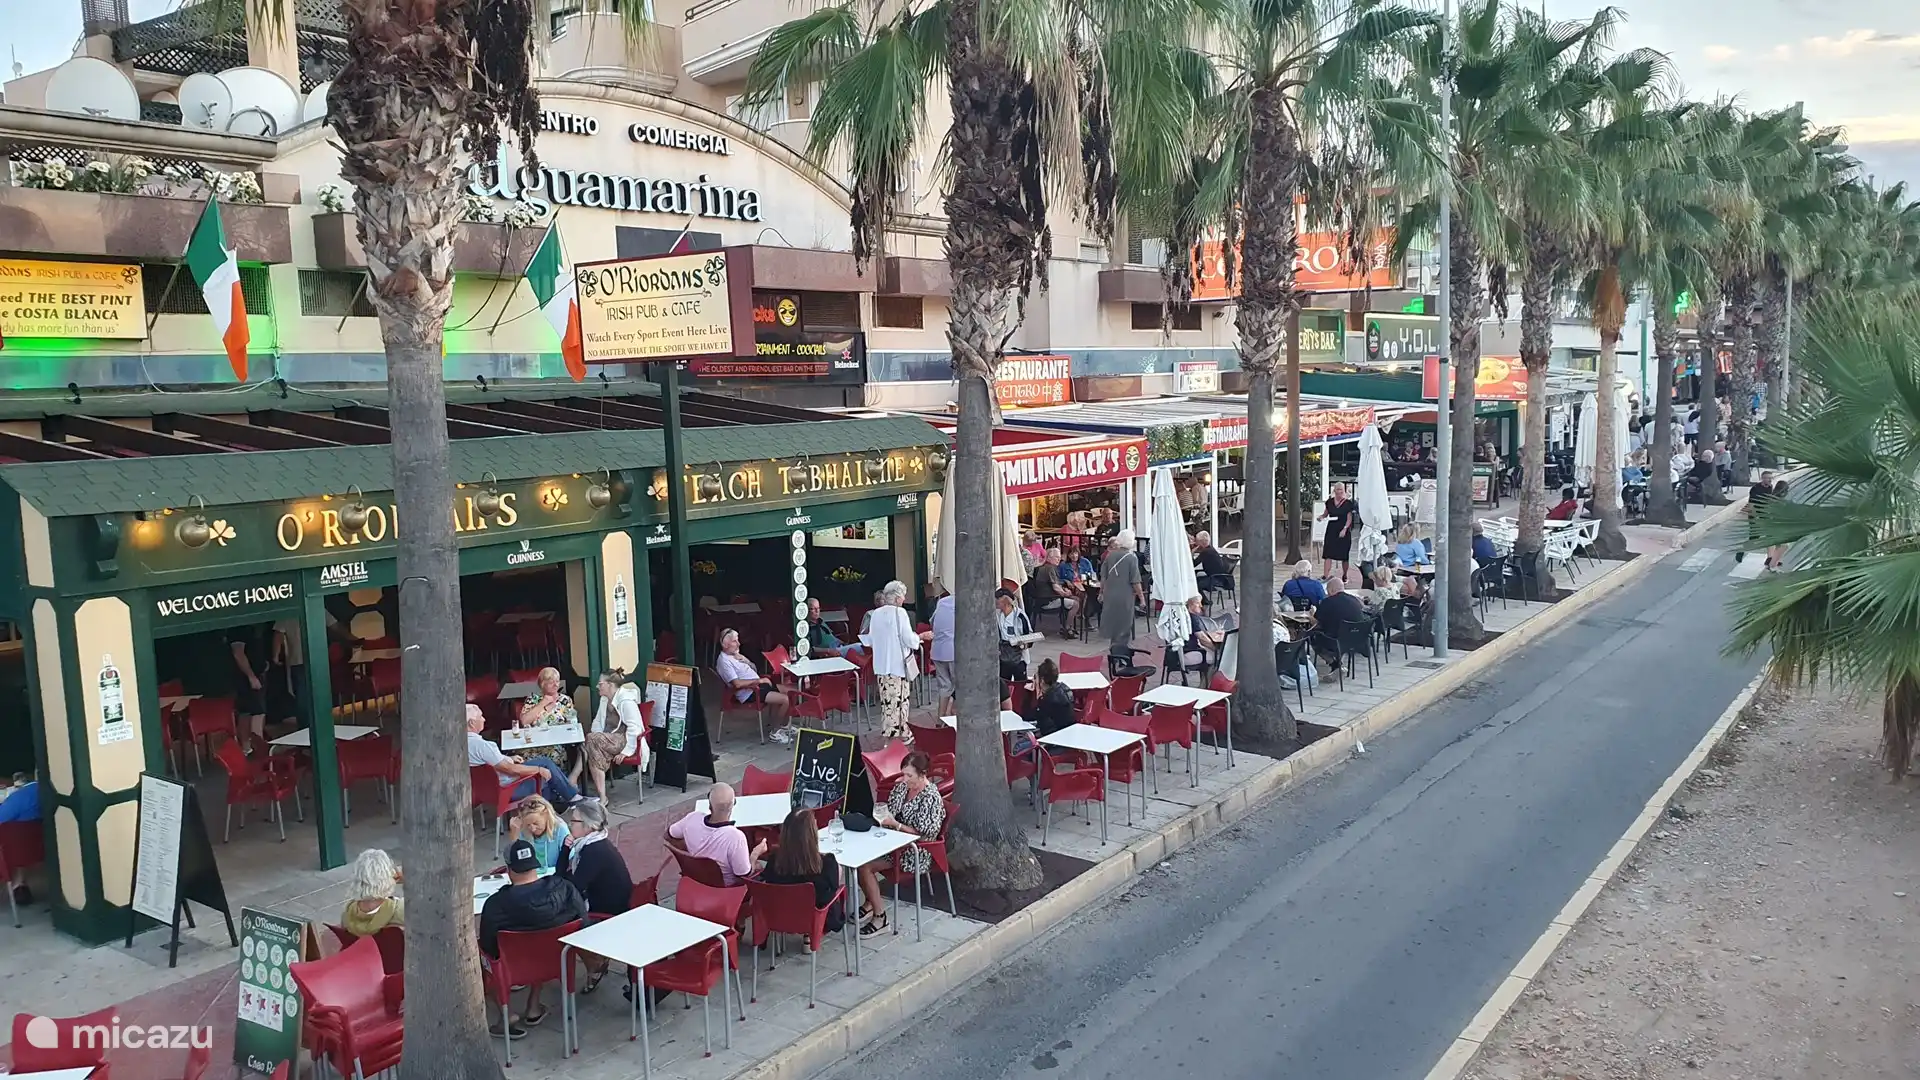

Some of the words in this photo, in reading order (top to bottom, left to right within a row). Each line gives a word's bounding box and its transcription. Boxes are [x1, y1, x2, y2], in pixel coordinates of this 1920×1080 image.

[631, 123, 736, 157] COMERCIAL
[37, 268, 61, 279] IRISH
[63, 269, 82, 280] PUB
[28, 292, 56, 304] THE
[61, 293, 97, 305] BEST
[101, 295, 133, 306] PINT
[14, 307, 59, 319] COSTA
[64, 309, 119, 320] BLANCA
[606, 306, 633, 321] IRISH
[636, 304, 659, 320] PUB
[662, 307, 669, 317] &
[17, 321, 36, 333] has
[81, 323, 103, 335] than
[587, 331, 611, 343] Watch
[613, 330, 635, 343] Every
[637, 329, 659, 342] Sport
[661, 327, 684, 339] Event
[687, 325, 707, 337] Here
[709, 323, 727, 335] Live
[1320, 331, 1336, 350] BAR
[588, 349, 598, 358] NO
[599, 348, 626, 357] MATTER
[627, 346, 647, 356] WHAT
[648, 345, 661, 354] THE
[663, 344, 686, 353] SPORT
[687, 342, 699, 351] WE
[700, 341, 719, 350] HAVE
[720, 341, 728, 349] IT
[711, 365, 734, 373] OLDEST
[735, 365, 747, 373] AND
[783, 365, 794, 373] BAR
[1069, 448, 1119, 479] JACK'S
[897, 492, 918, 504] AMSTEL
[785, 515, 812, 526] GUINNESS
[507, 550, 546, 565] GUINNESS
[320, 561, 369, 581] AMSTEL
[157, 590, 240, 617] WELCOME
[244, 583, 294, 605] HOME!
[796, 754, 843, 782] Live!
